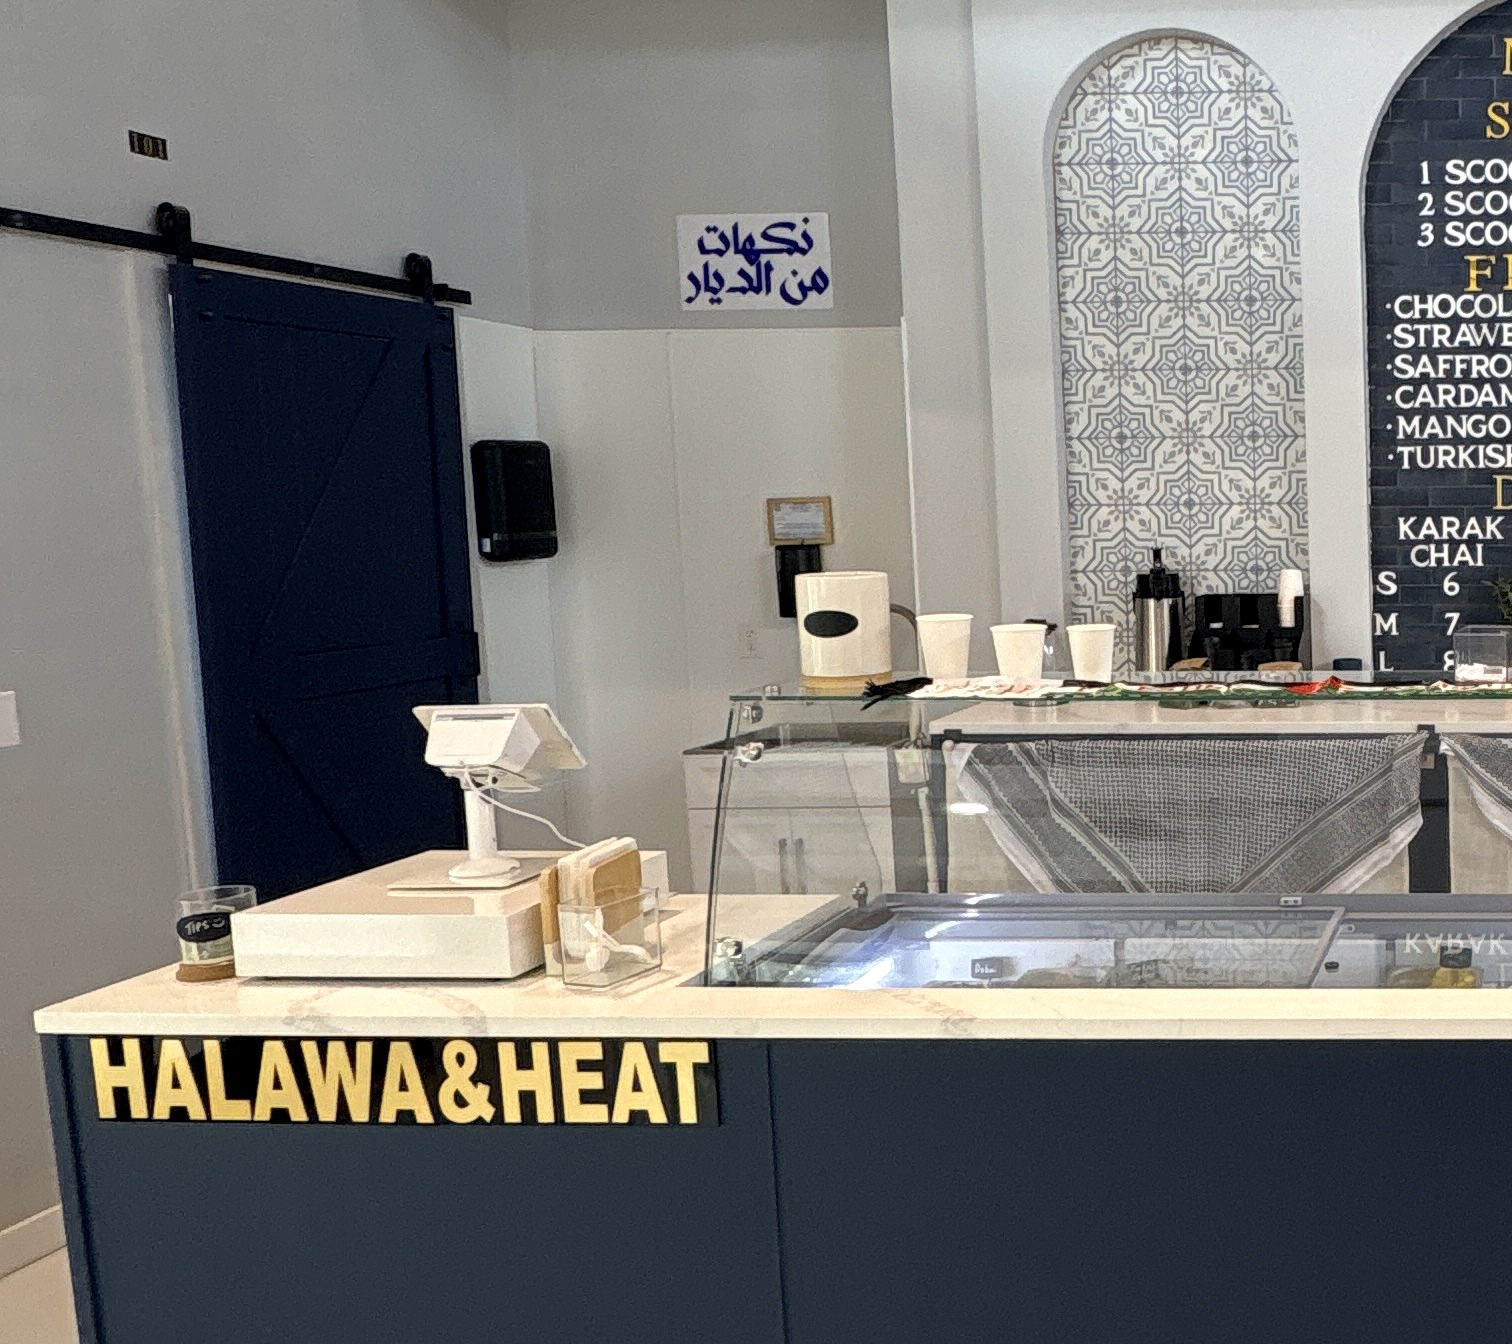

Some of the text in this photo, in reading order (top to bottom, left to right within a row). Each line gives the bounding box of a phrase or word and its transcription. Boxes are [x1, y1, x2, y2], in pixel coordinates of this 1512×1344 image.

[1420, 160, 1431, 185] 1
[1417, 192, 1436, 217] 2
[697, 216, 814, 266] نكهات
[1416, 222, 1435, 248] 3
[684, 259, 830, 306] من الديار
[1396, 413, 1512, 440] MANGO
[1397, 515, 1505, 540] KARAK
[1410, 543, 1484, 568] CHAI
[1375, 570, 1398, 596] S
[1442, 571, 1460, 597] 6
[1373, 612, 1399, 636] M
[1444, 612, 1461, 636] 7
[1379, 650, 1394, 672] L
[89, 1037, 710, 1124] HALAWA&HEAT
